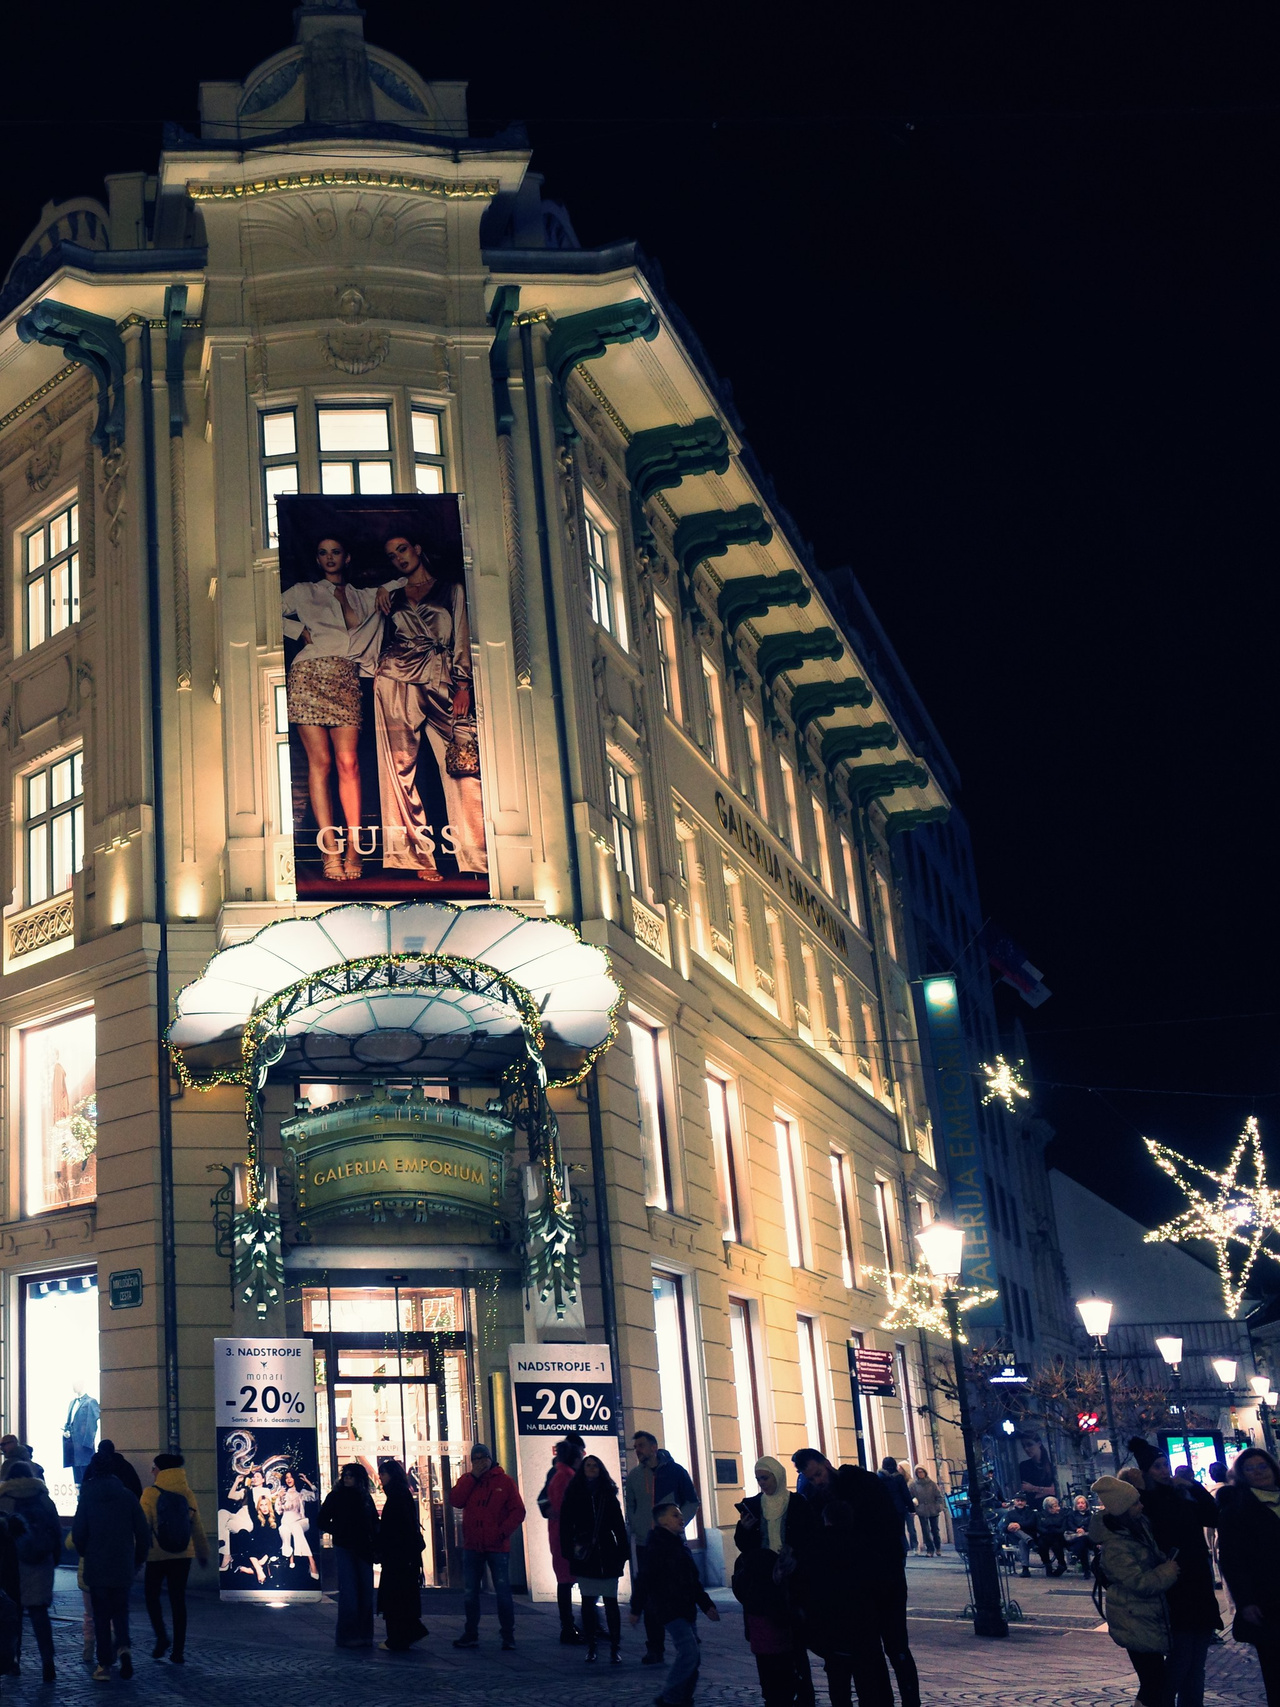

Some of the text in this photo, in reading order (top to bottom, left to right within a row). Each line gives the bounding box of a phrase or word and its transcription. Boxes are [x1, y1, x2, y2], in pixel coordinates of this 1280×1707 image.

[316, 824, 462, 856] GUESS
[715, 791, 849, 958] GALERIJA EMPORIUM
[928, 993, 976, 1158] EMPORIUM
[313, 1158, 485, 1186] GALERIJA EMPORIUM
[226, 1347, 301, 1356] 3. NADSTROPJE
[518, 1361, 605, 1371] NADSTROPJE -1
[226, 1385, 305, 1414] -20%
[521, 1388, 611, 1421] -20%
[53, 1483, 81, 1496] BOSS
